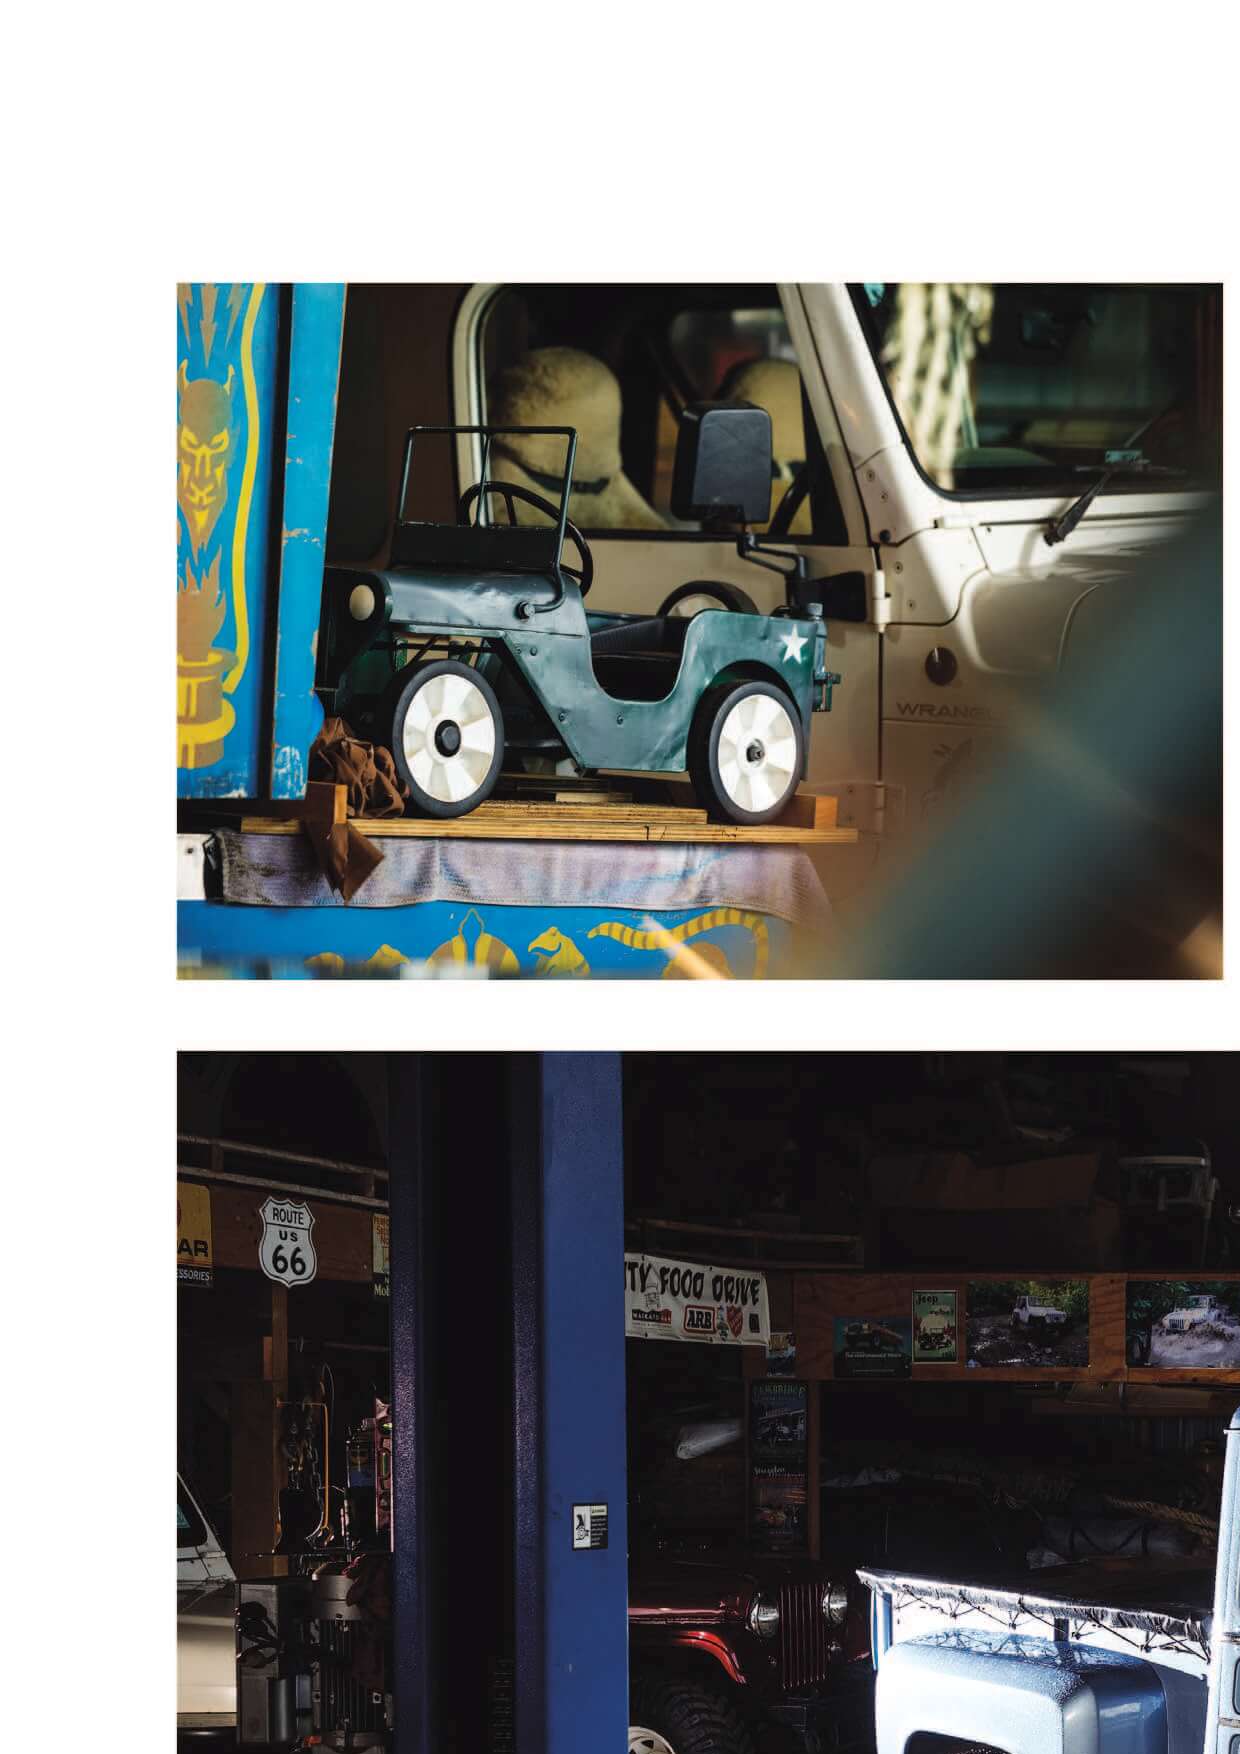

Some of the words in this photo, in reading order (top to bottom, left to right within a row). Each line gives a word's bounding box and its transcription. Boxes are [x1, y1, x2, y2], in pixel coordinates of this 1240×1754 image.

[272, 1207, 305, 1225] ROUTE
[279, 1230, 299, 1242] US
[271, 1244, 306, 1276] 66
[660, 1266, 704, 1300] FOOD
[712, 1275, 761, 1306] DRIVE
[687, 1310, 713, 1329] ARB
